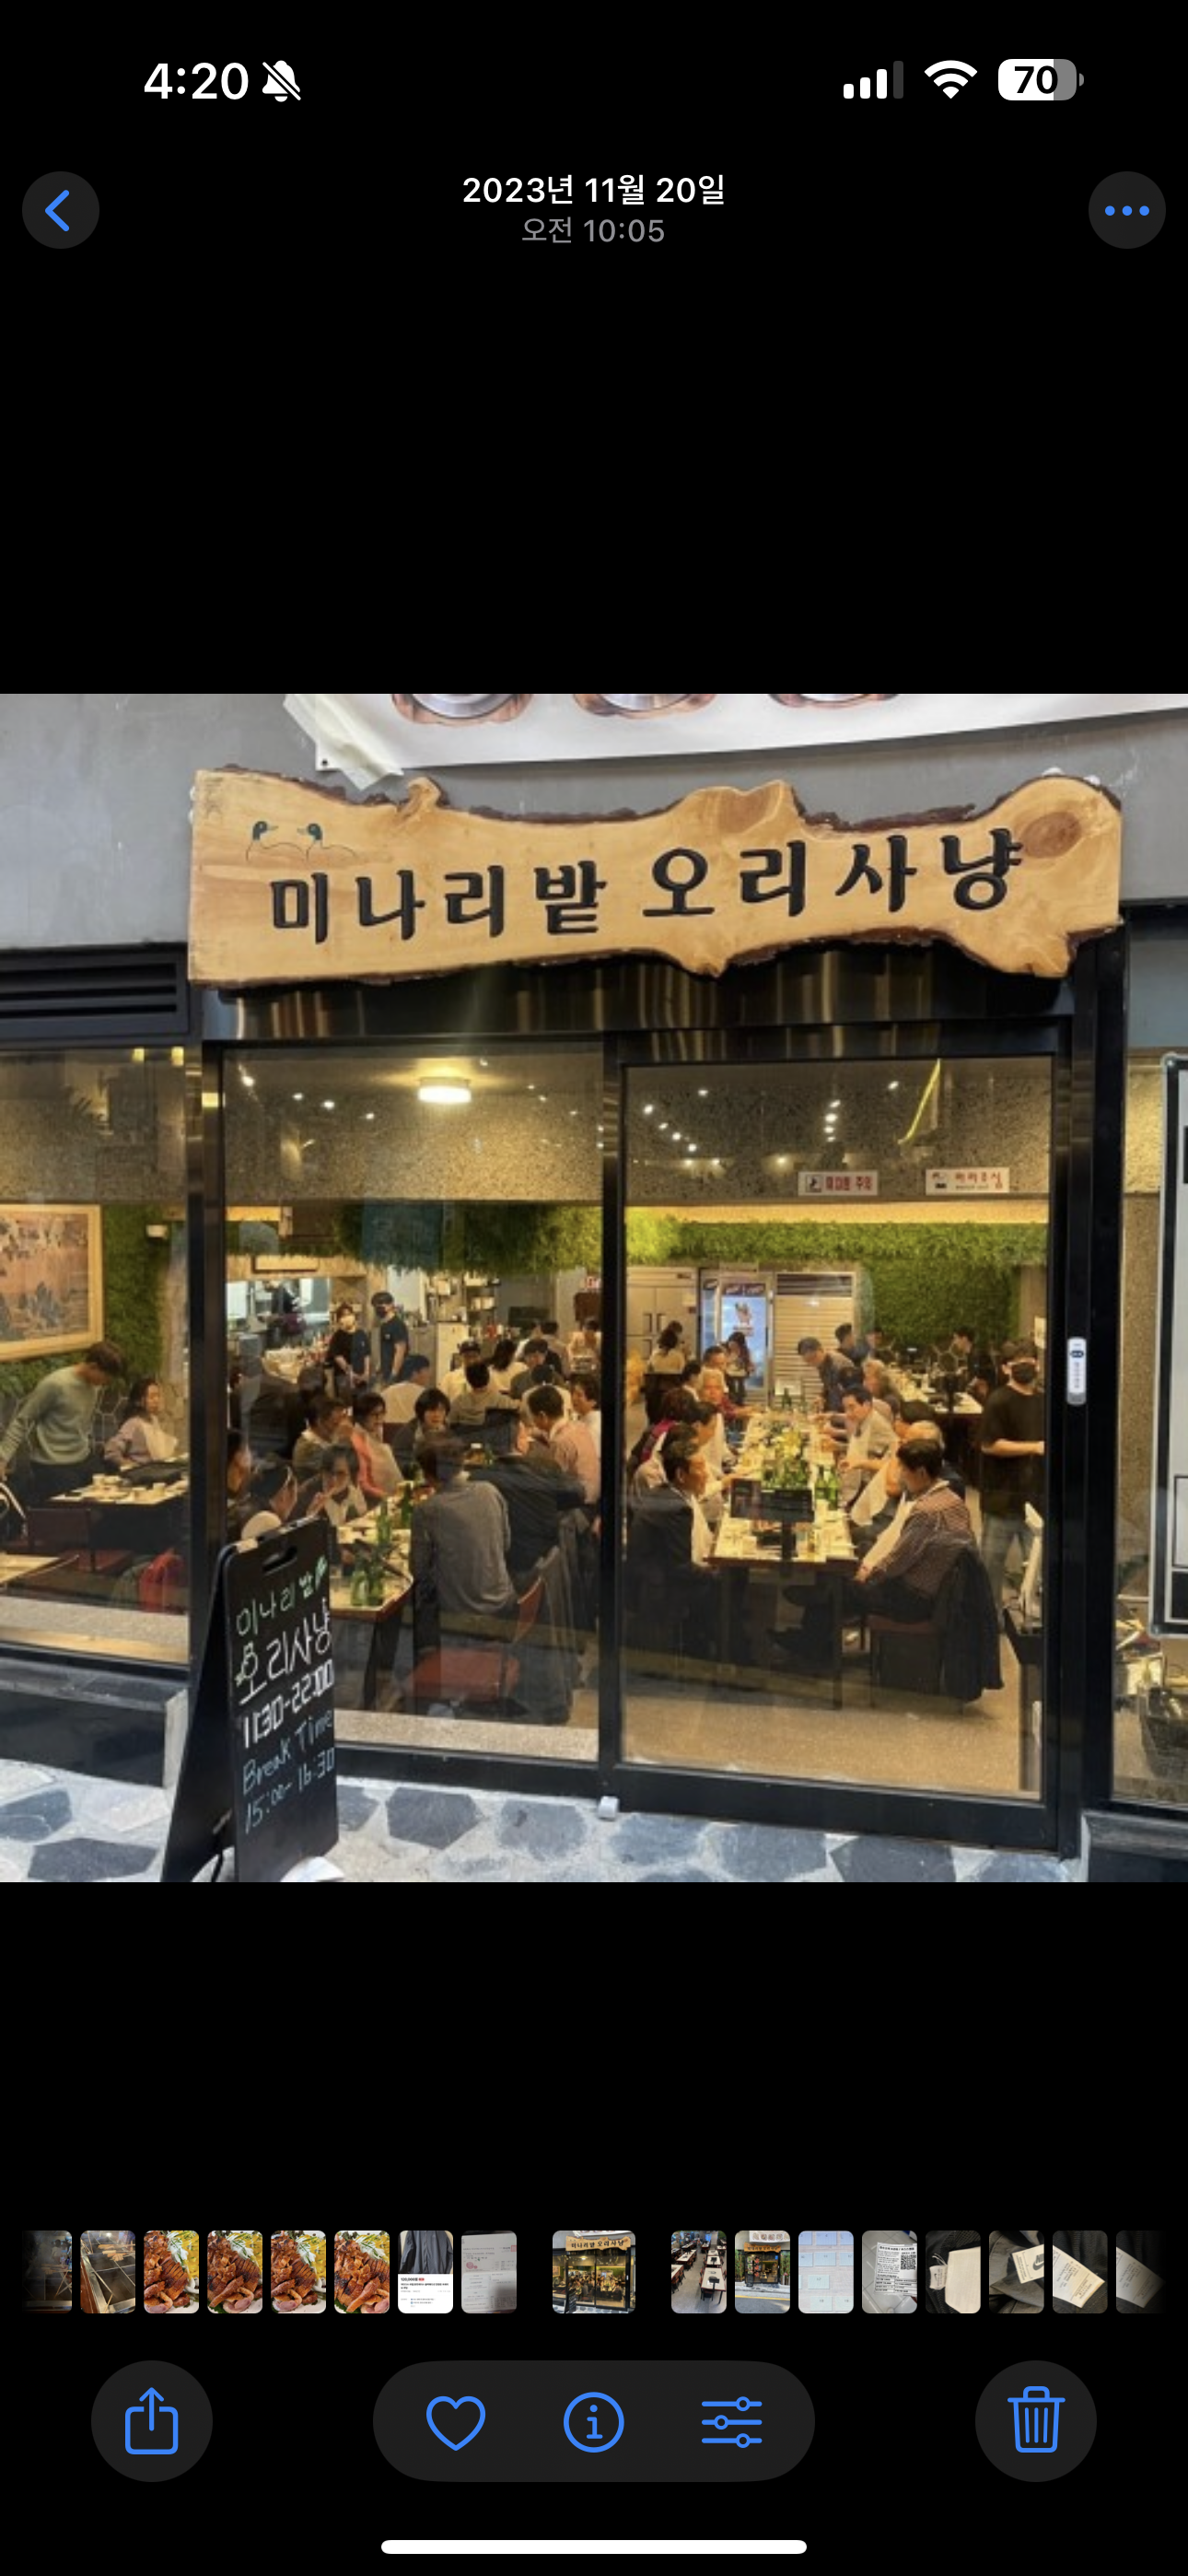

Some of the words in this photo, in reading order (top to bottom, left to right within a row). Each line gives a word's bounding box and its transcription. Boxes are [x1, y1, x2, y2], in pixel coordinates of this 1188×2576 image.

[270, 860, 608, 945] 미나리밭
[643, 827, 1024, 918] 오리사냥
[238, 1597, 332, 1705] 오리사냥
